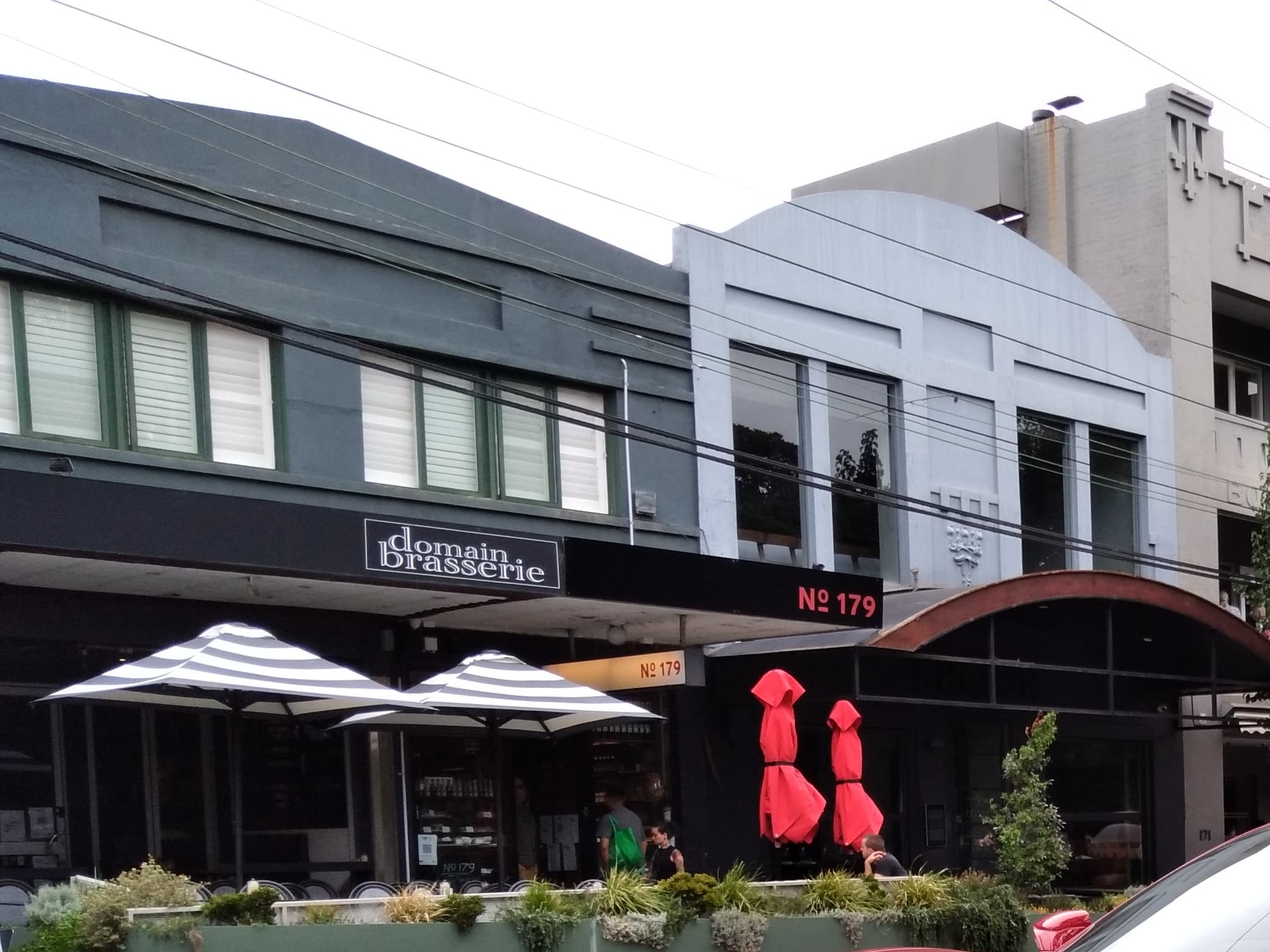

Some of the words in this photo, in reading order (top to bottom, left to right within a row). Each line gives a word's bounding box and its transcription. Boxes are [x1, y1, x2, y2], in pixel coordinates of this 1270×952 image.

[387, 526, 508, 563] domain
[378, 540, 545, 583] brasserie
[836, 592, 876, 618] 179
[659, 660, 681, 677] 179
[458, 862, 476, 874] 179
